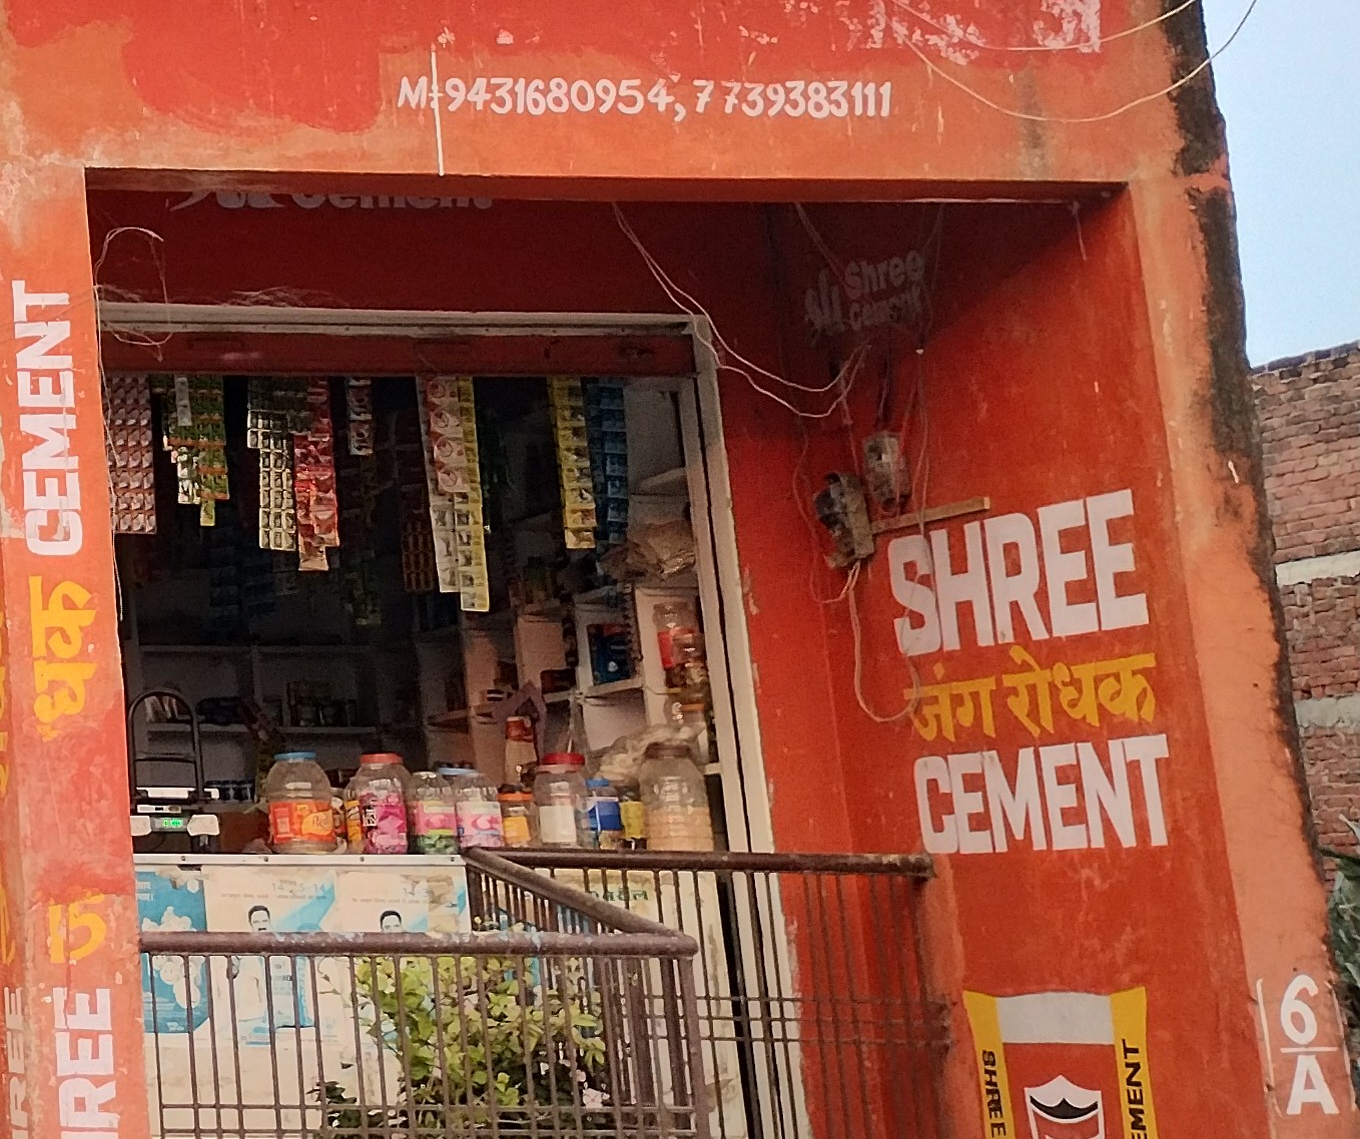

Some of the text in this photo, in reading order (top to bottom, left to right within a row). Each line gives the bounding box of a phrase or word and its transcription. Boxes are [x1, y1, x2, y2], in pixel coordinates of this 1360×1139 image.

[11, 278, 83, 557] CEMENT
[886, 486, 1150, 658] SHREE
[903, 645, 1158, 743] जंग रोधक
[912, 732, 1170, 855] CEMENT
[1279, 973, 1319, 1045] 6
[981, 1048, 1006, 1139] SHREE
[1285, 1054, 1341, 1116] A
